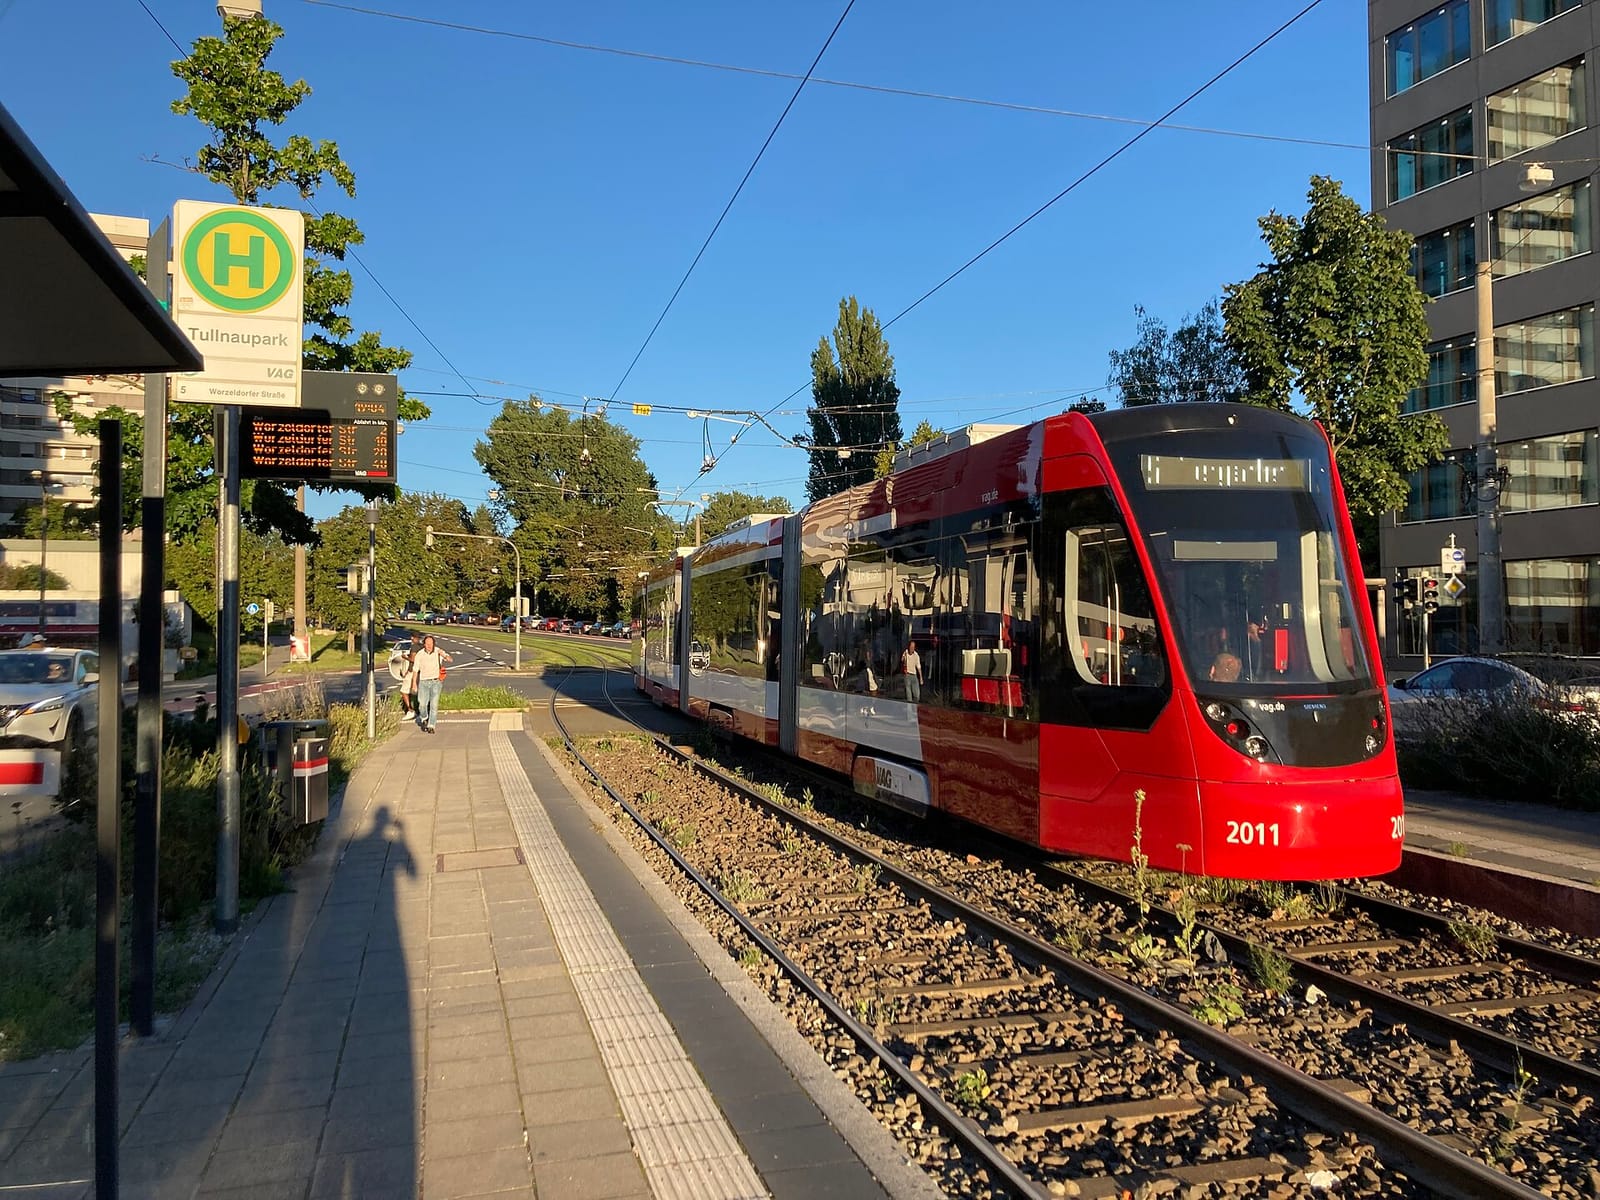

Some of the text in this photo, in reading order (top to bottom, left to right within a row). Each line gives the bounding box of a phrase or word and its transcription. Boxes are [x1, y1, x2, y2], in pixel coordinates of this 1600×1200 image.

[213, 231, 266, 289] H
[188, 327, 289, 348] Tullnaupark
[267, 367, 294, 379] VAG
[180, 386, 187, 394] 5
[209, 388, 260, 398] Worzeldorfer
[1259, 701, 1285, 713] vag.de
[876, 766, 892, 789] VAG
[1226, 820, 1279, 846] 2011
